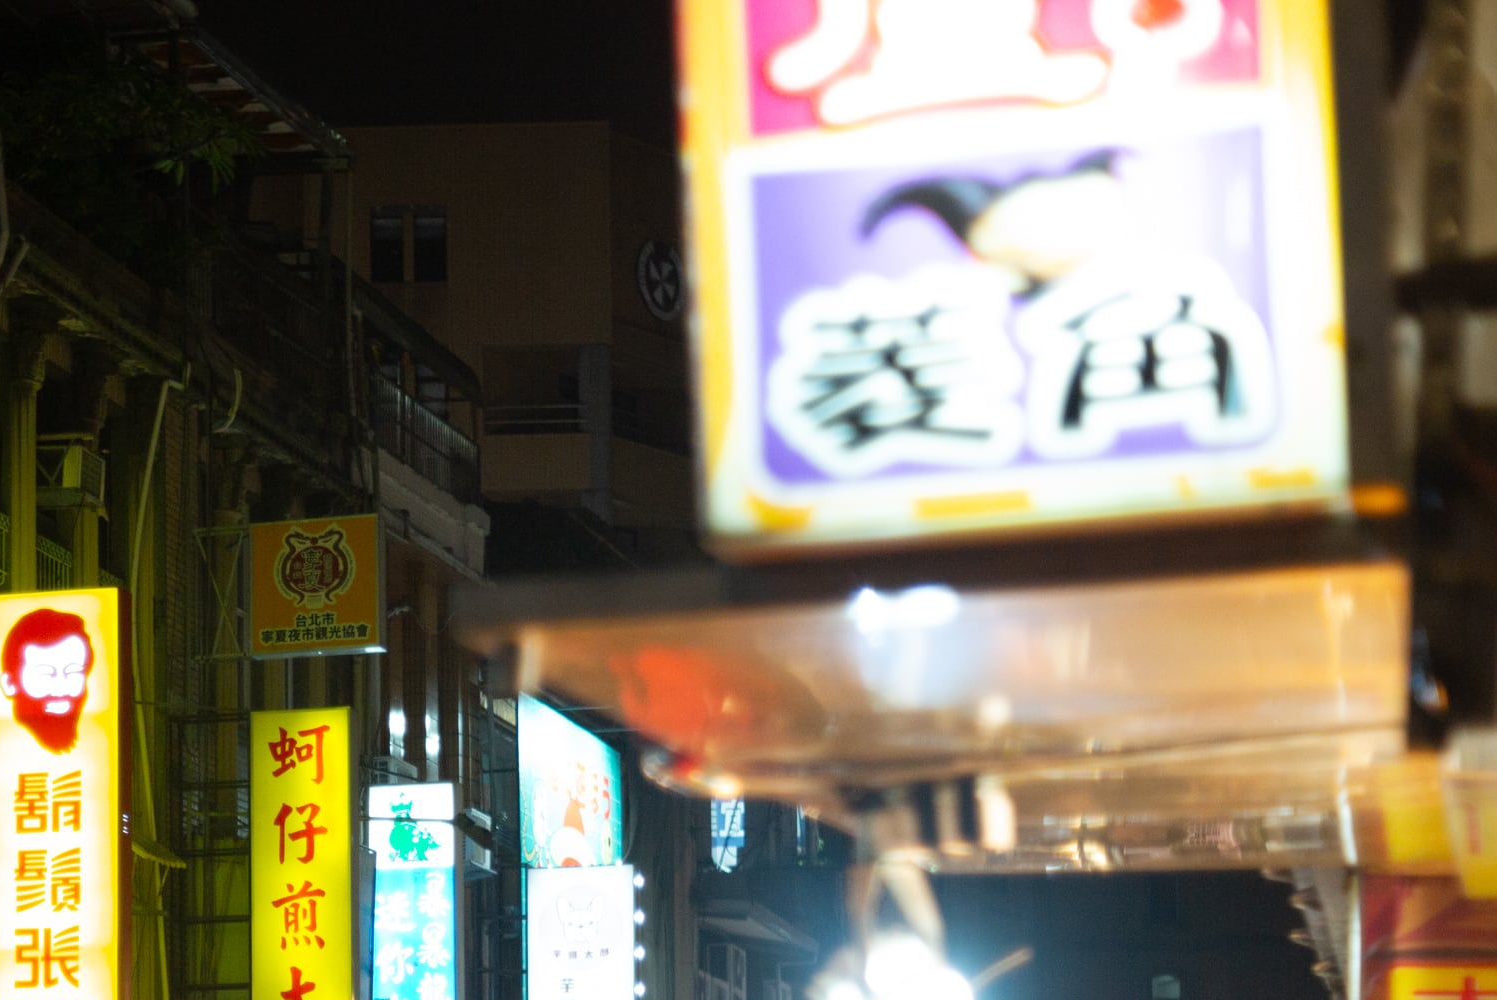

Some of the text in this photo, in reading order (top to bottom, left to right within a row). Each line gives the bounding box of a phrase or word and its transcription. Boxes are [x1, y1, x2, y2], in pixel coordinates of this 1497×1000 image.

[295, 613, 336, 628] 台北市
[261, 624, 369, 643] 寧夏夜市觀光協會
[13, 769, 82, 989] 鬍鬚張
